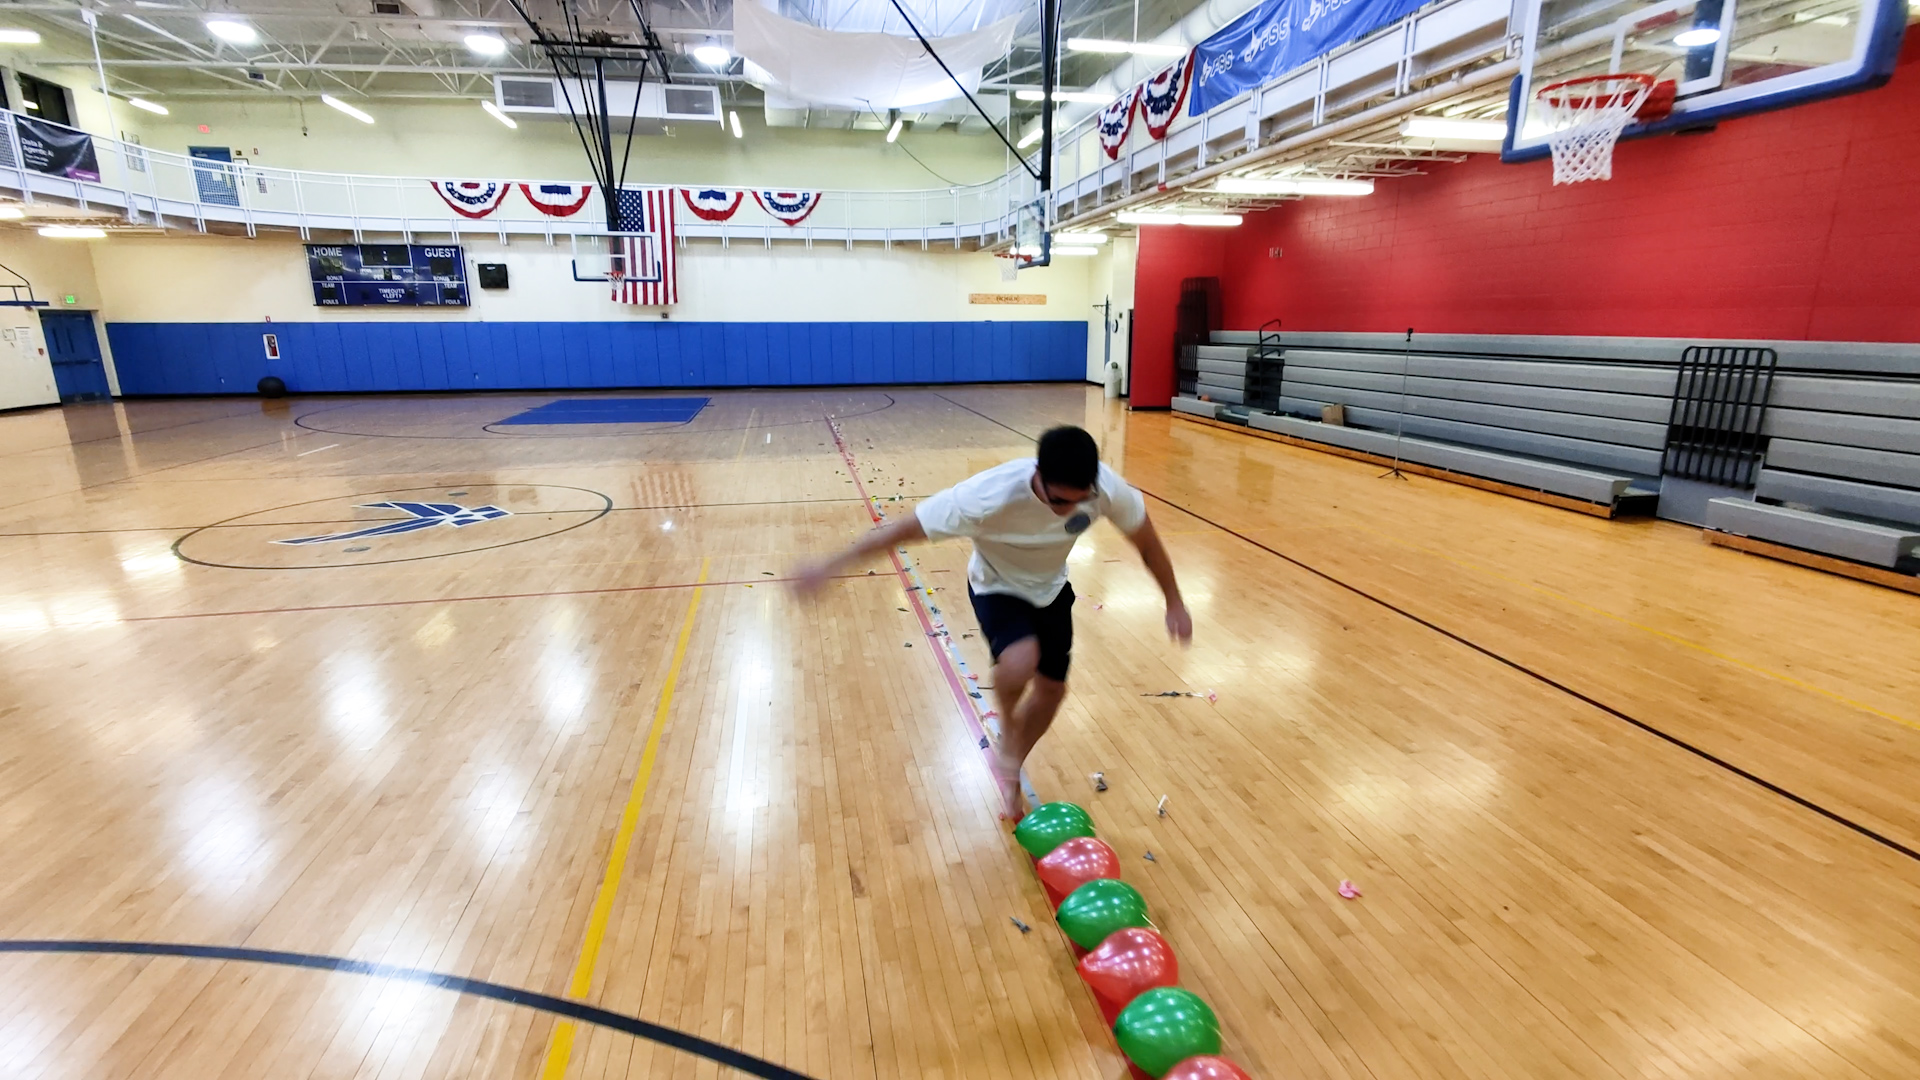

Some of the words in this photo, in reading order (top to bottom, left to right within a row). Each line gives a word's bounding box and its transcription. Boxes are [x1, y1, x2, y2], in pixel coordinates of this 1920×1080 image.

[1260, 17, 1290, 51] FSS
[1210, 50, 1234, 77] FSS
[21, 137, 38, 147] Data
[313, 247, 343, 257] HOME
[424, 248, 457, 258] GUEST
